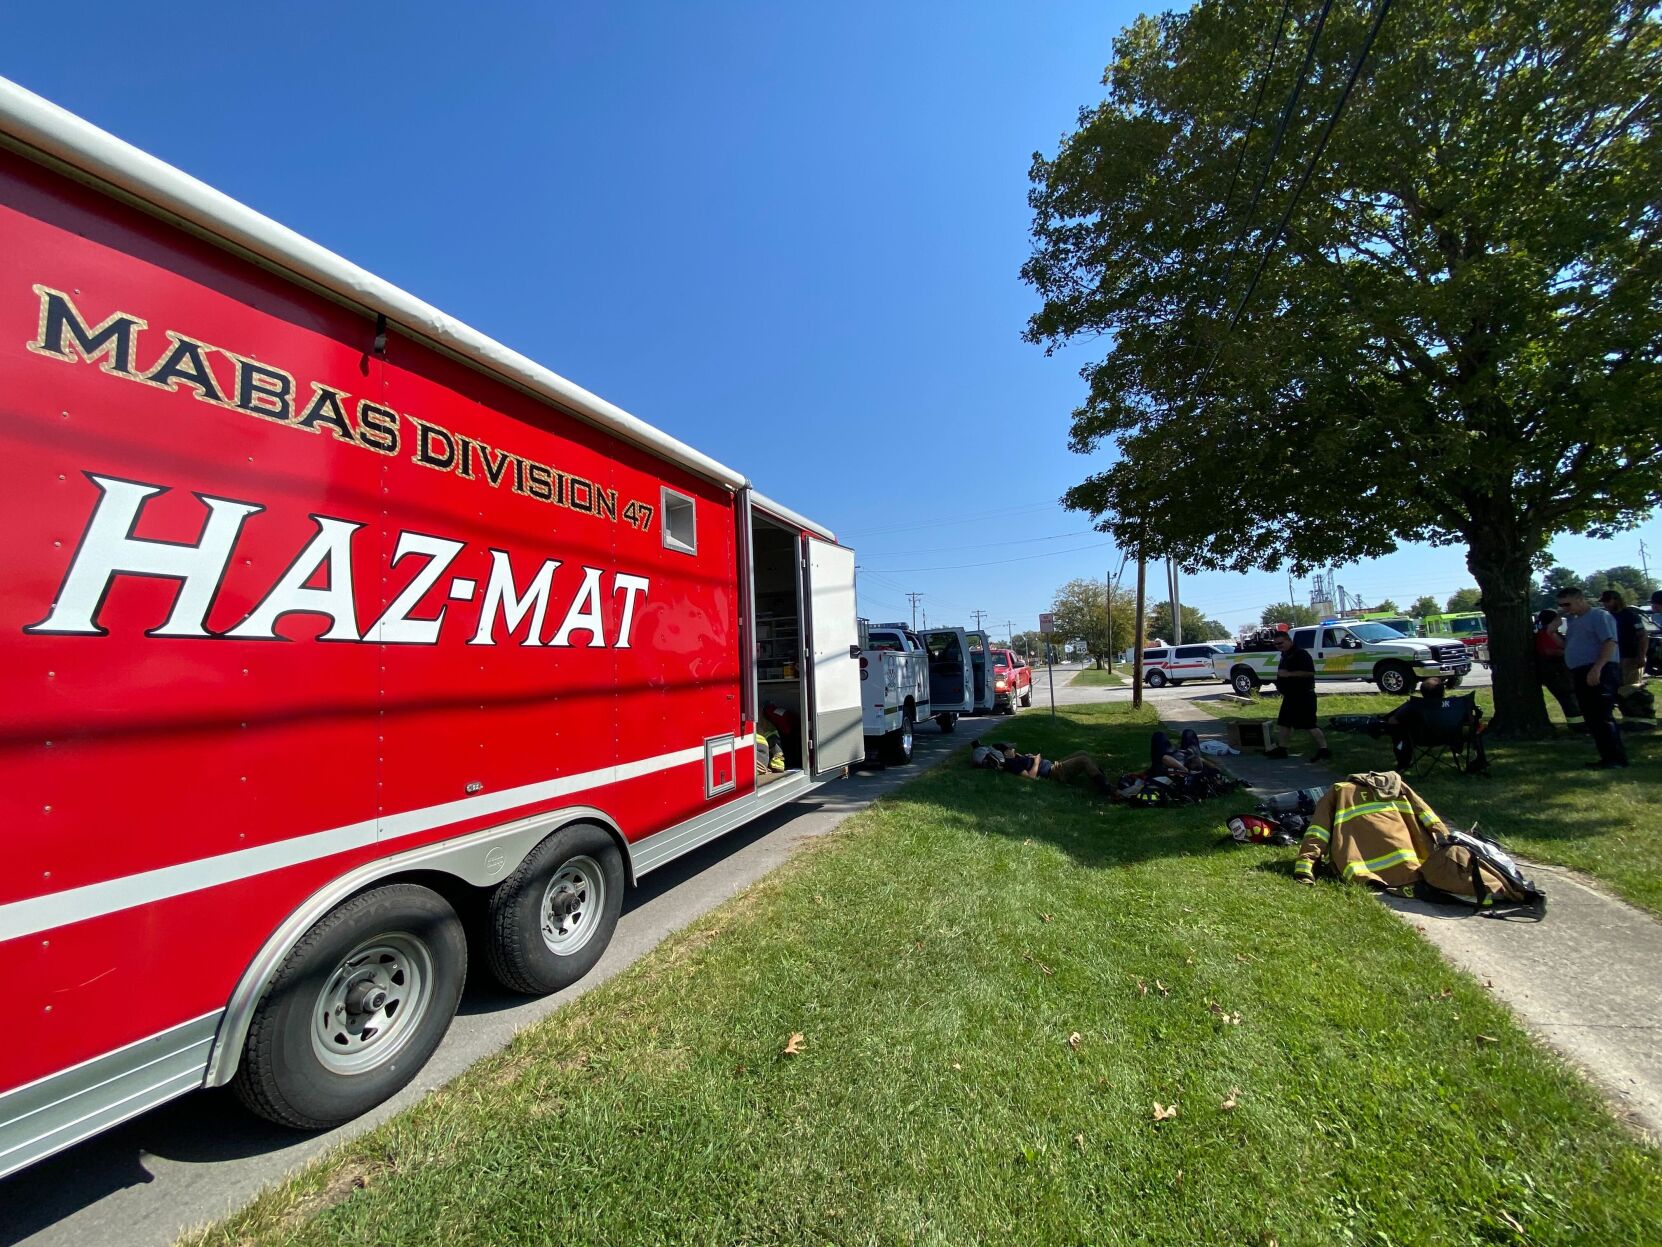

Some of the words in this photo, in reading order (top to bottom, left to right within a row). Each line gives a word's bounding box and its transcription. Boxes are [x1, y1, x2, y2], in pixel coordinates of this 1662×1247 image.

[27, 284, 400, 456] MABAS
[404, 414, 618, 522] DIVISION
[622, 500, 654, 531] 47
[24, 472, 650, 648] HAZ-MAT
